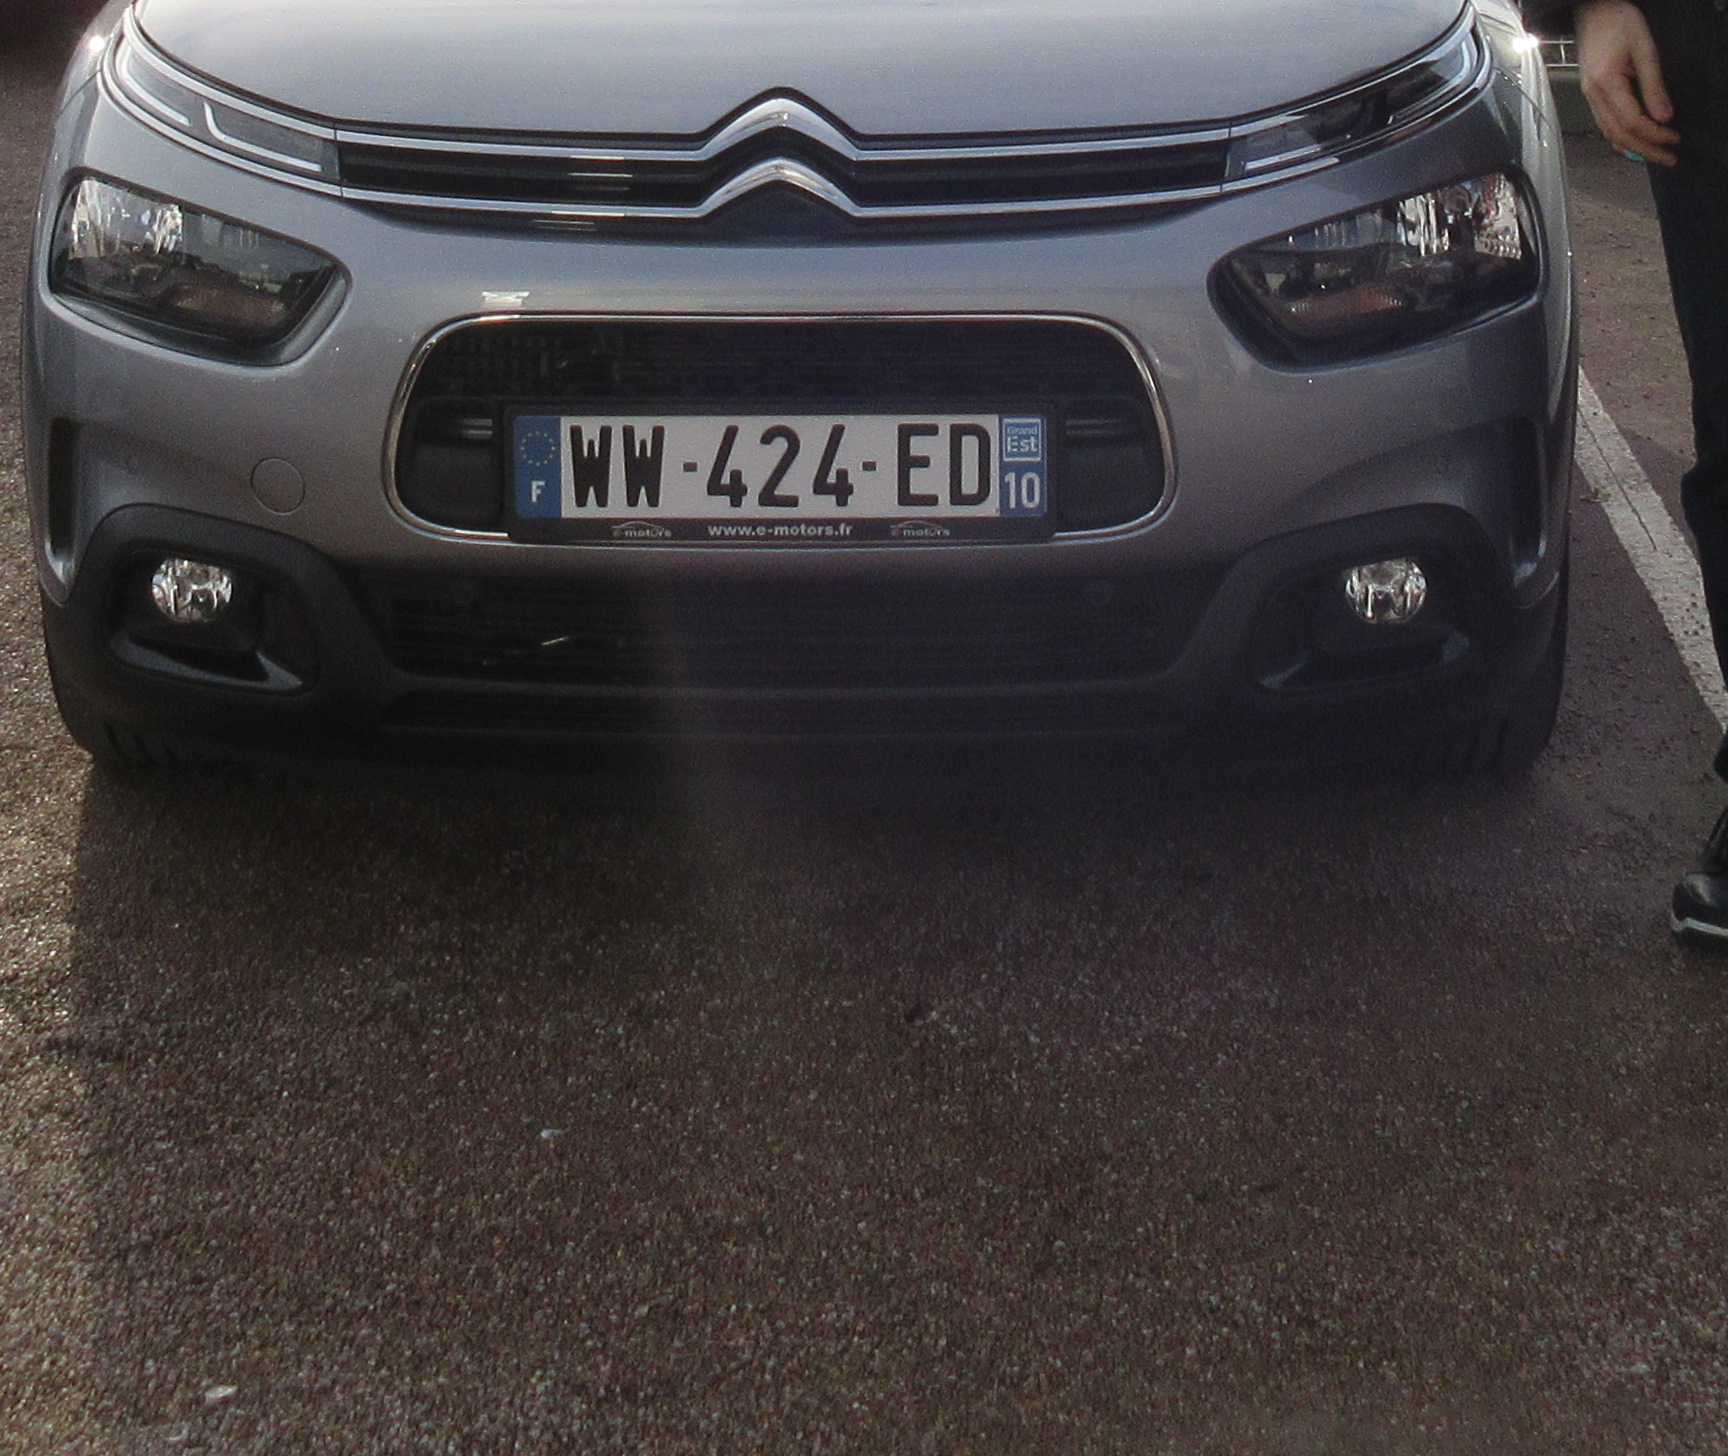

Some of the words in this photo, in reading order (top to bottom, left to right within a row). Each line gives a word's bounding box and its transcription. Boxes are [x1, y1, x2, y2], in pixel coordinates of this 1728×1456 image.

[1006, 426, 1038, 435] Grand
[1006, 435, 1038, 453] Est
[569, 423, 991, 507] WW-424-ED
[531, 480, 546, 503] F
[1004, 471, 1041, 509] 10
[707, 522, 853, 537] www.e-motors.fr
